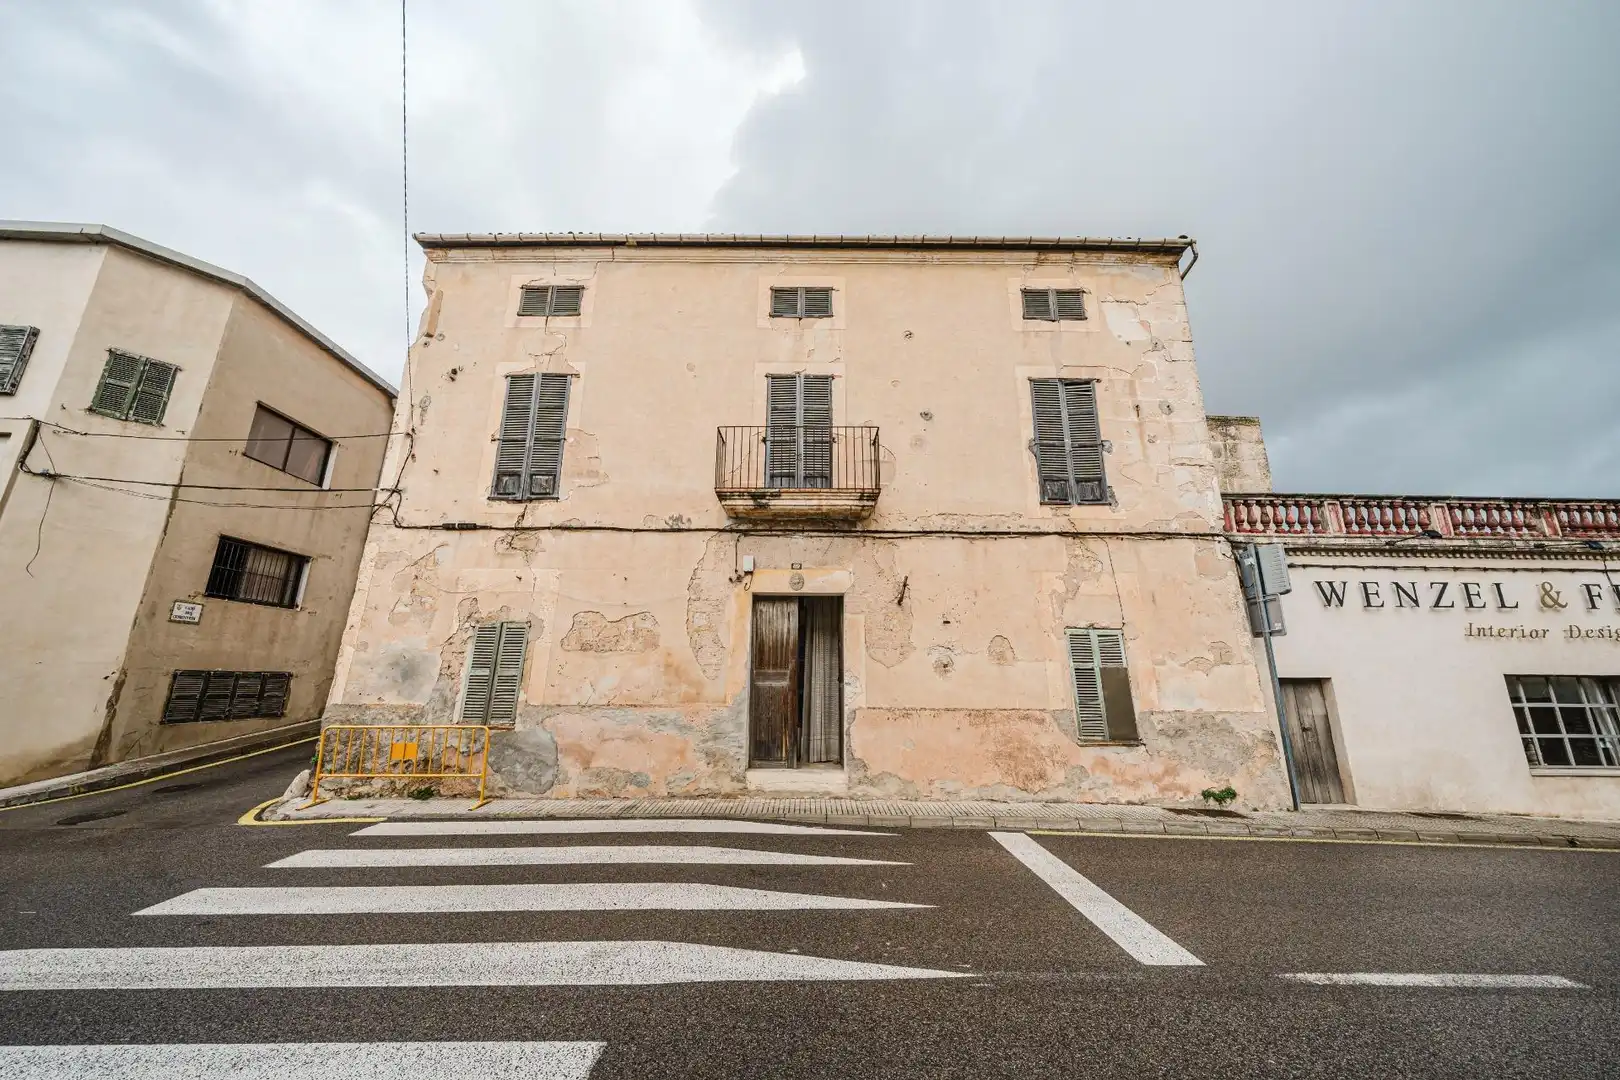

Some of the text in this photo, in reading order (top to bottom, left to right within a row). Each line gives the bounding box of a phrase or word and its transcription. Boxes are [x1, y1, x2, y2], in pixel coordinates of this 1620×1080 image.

[1313, 580, 1519, 609] WENZEL
[1538, 580, 1568, 609] &
[1466, 622, 1550, 639] Interior
